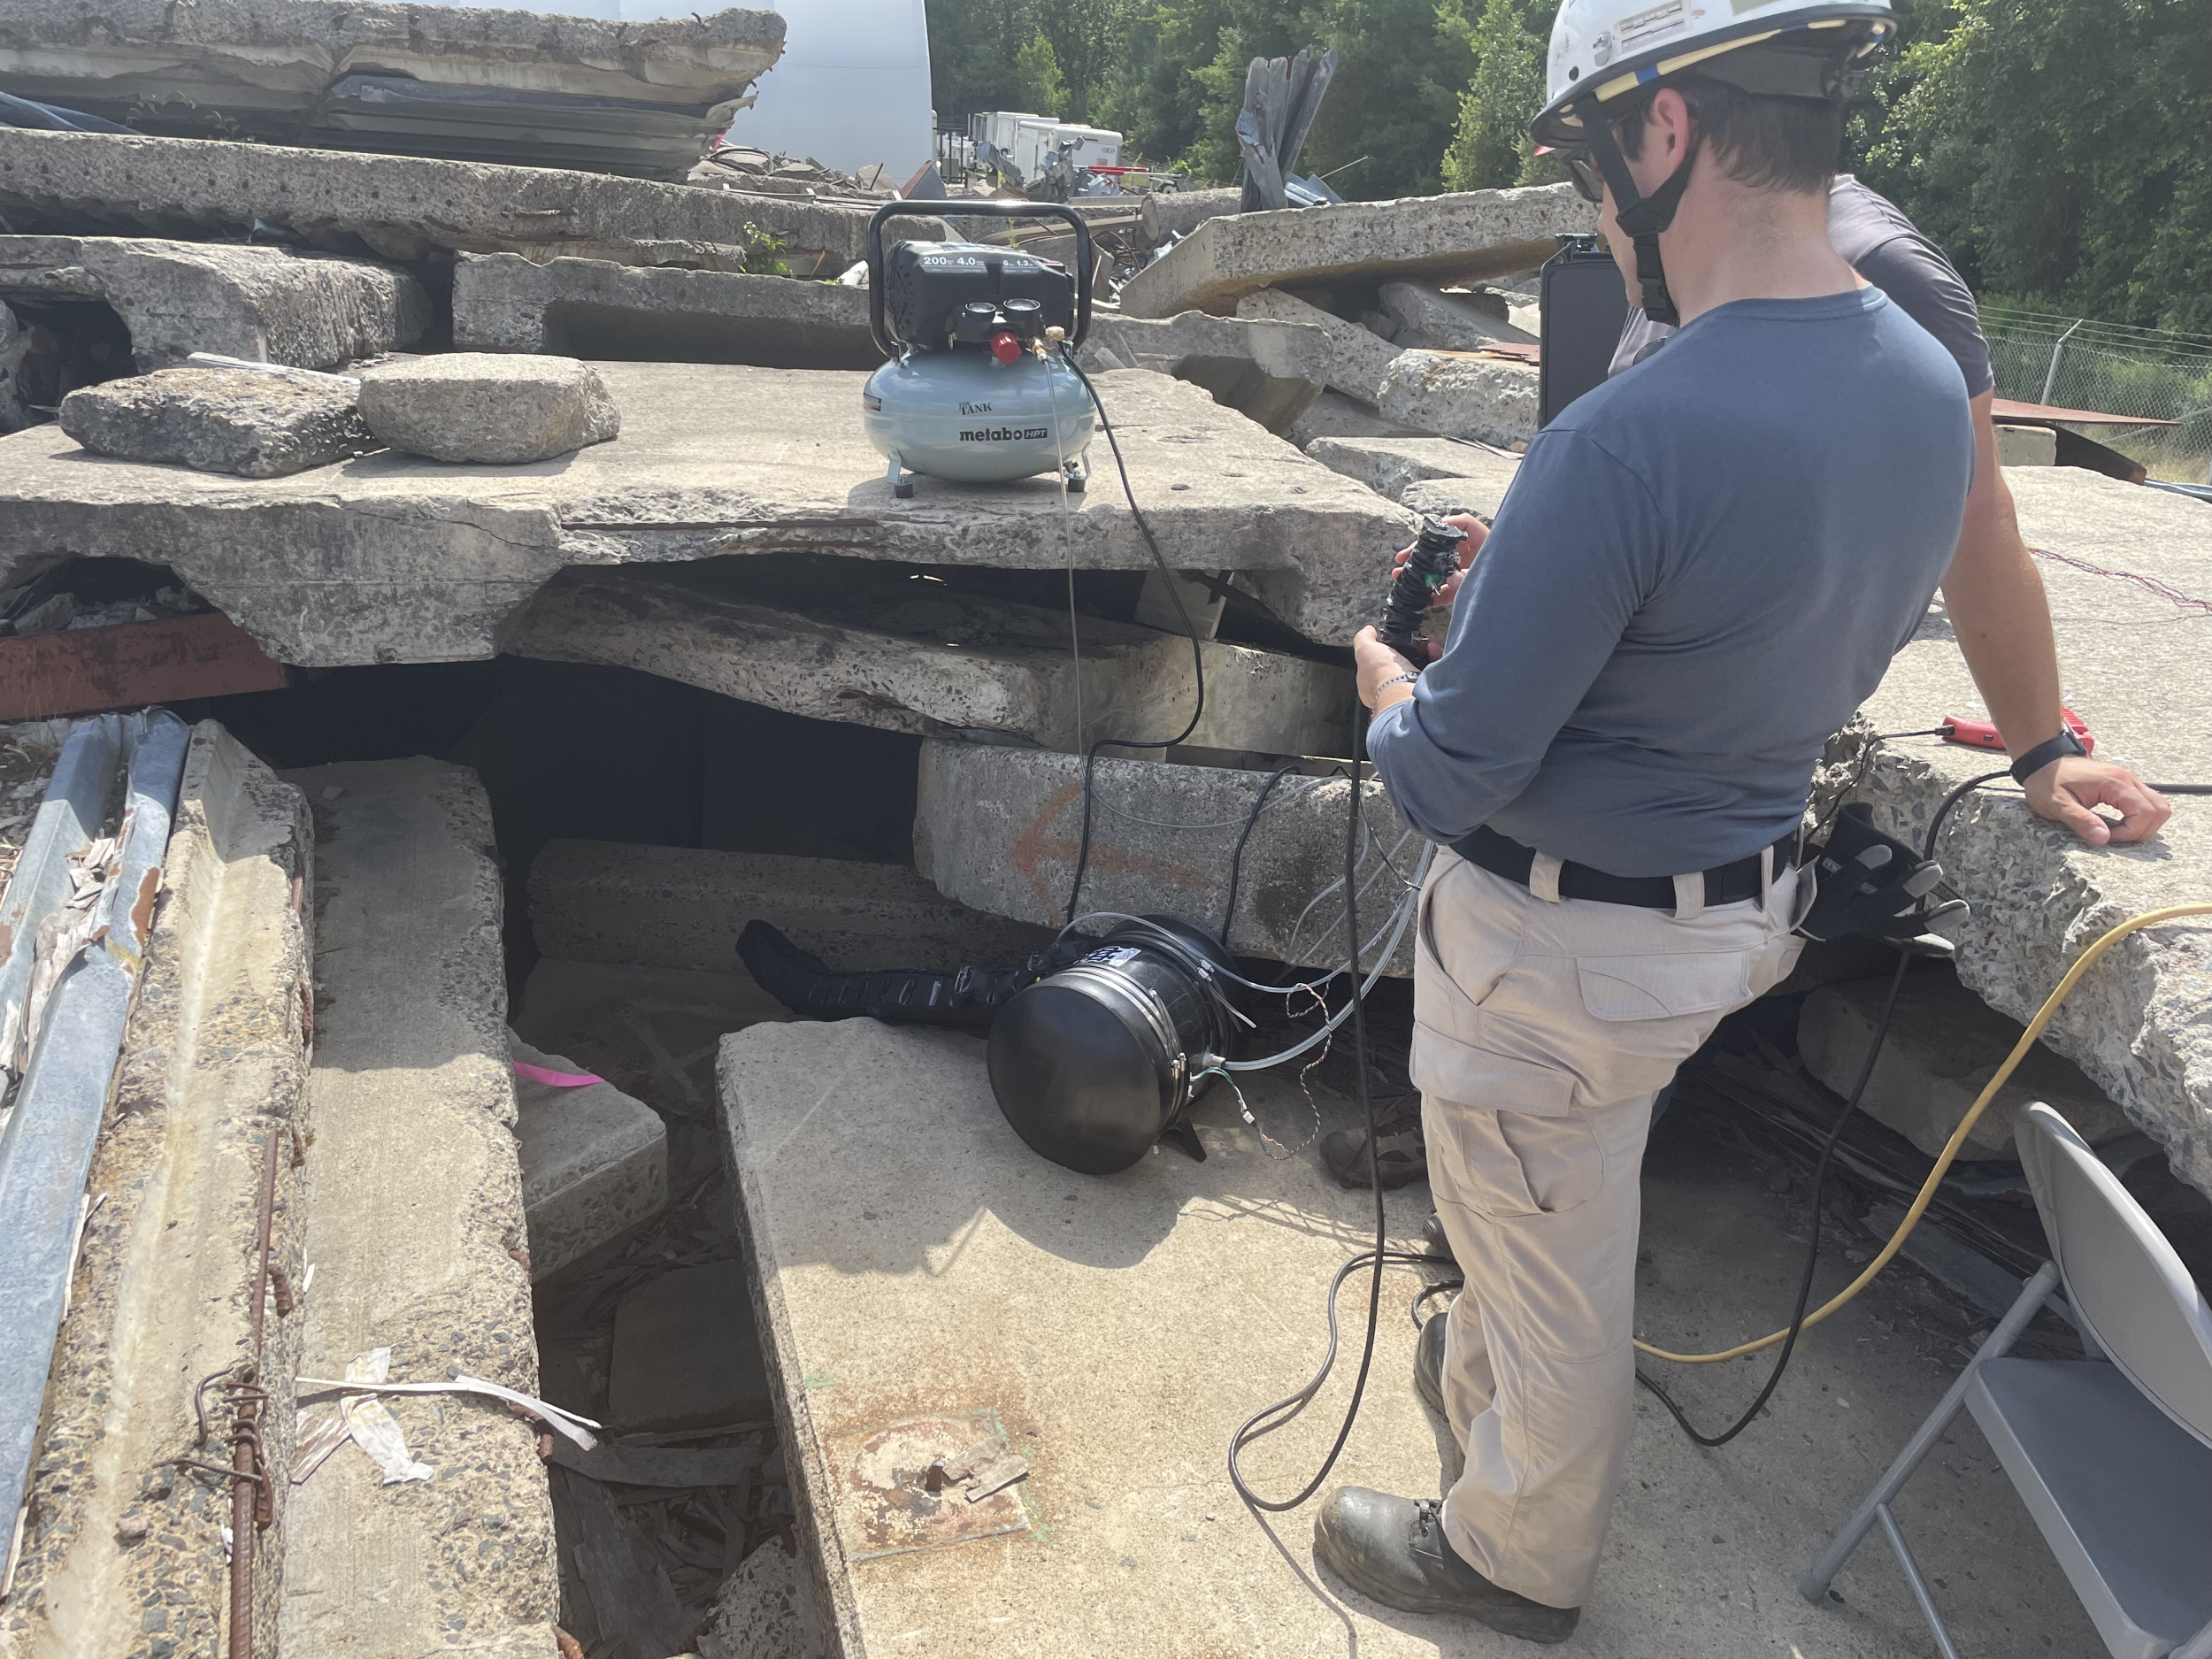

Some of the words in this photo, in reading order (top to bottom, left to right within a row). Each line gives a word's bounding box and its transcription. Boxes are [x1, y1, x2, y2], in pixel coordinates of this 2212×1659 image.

[924, 257, 947, 265] 200
[957, 257, 976, 265] 4.0
[961, 403, 993, 416] TANK
[960, 427, 1023, 442] metabo
[1025, 429, 1047, 439] HPT
